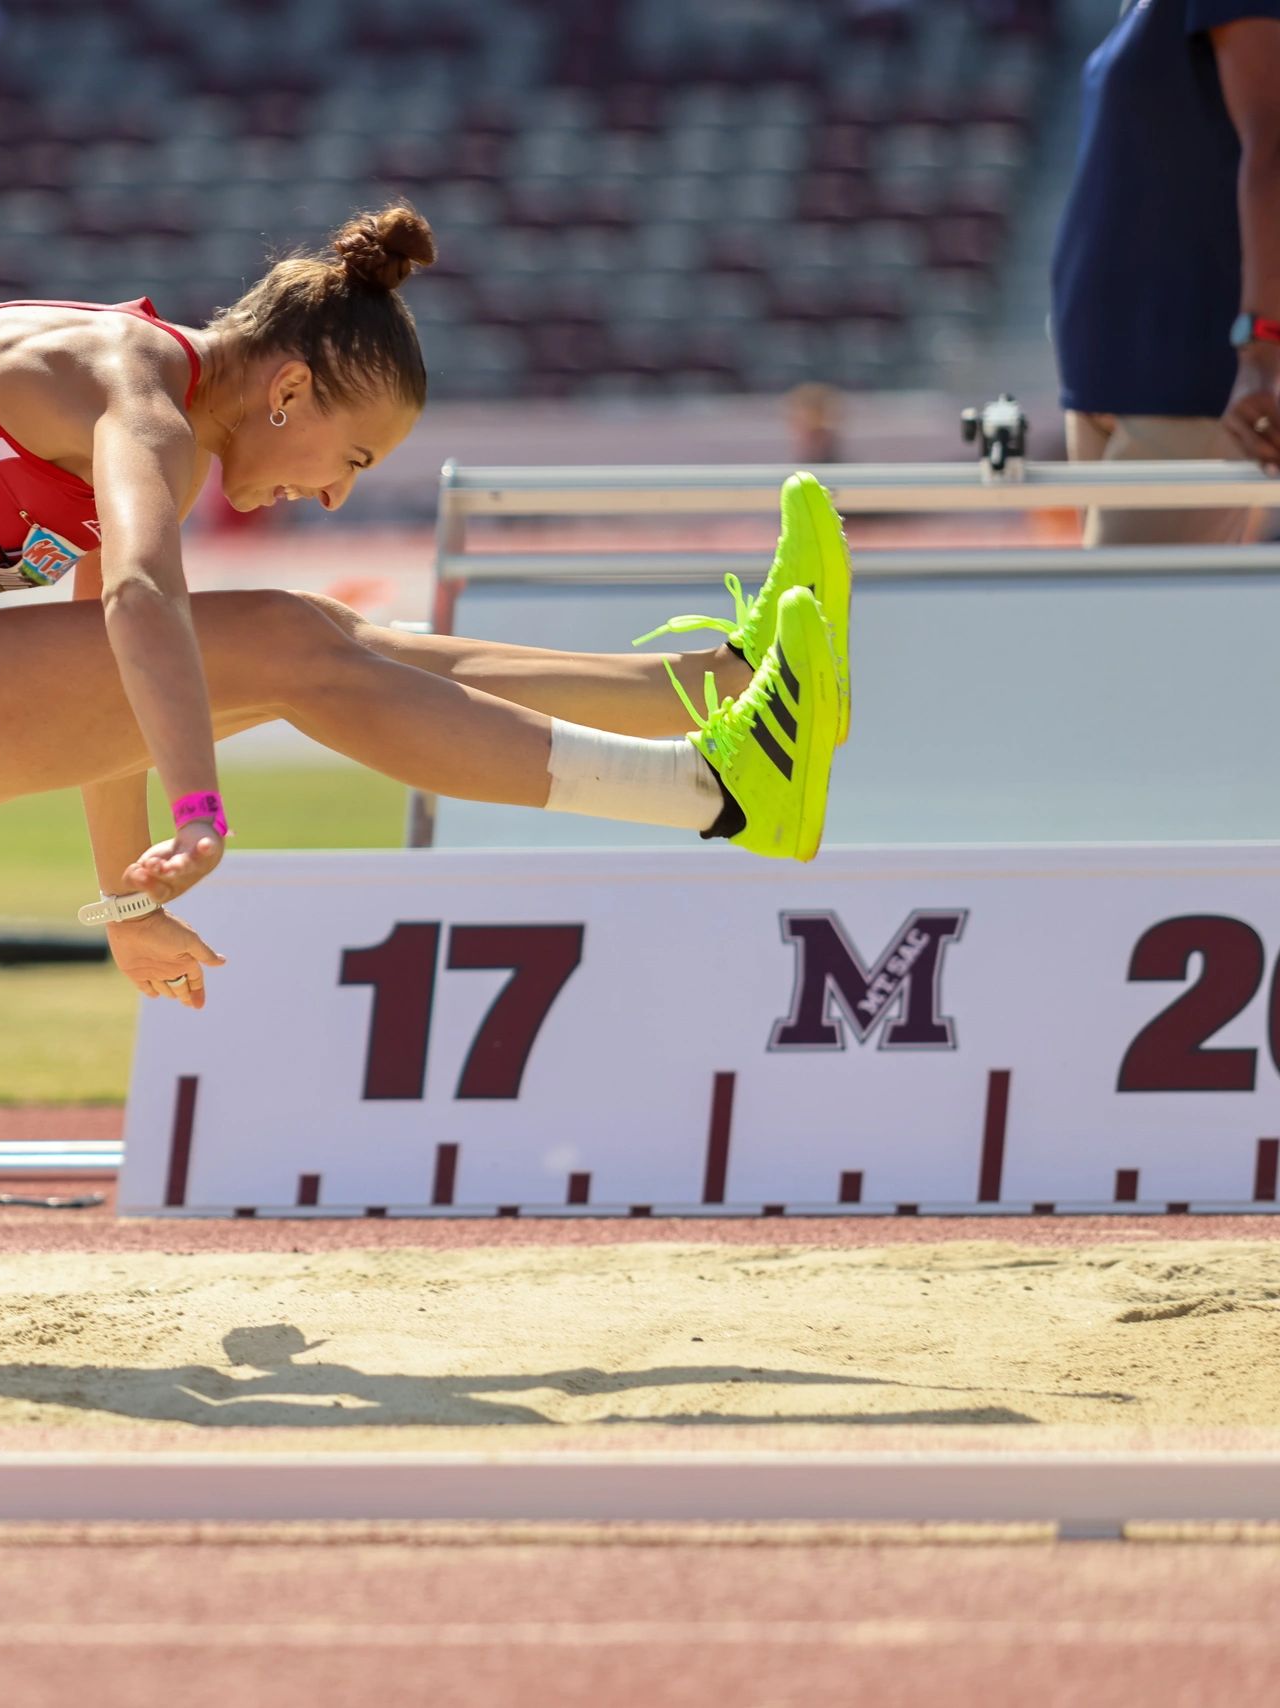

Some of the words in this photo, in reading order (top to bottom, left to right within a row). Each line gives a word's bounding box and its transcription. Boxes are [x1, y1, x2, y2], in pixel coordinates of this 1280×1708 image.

[338, 920, 585, 1101] 17
[767, 909, 969, 1052] M
[1115, 914, 1280, 1093] 2
